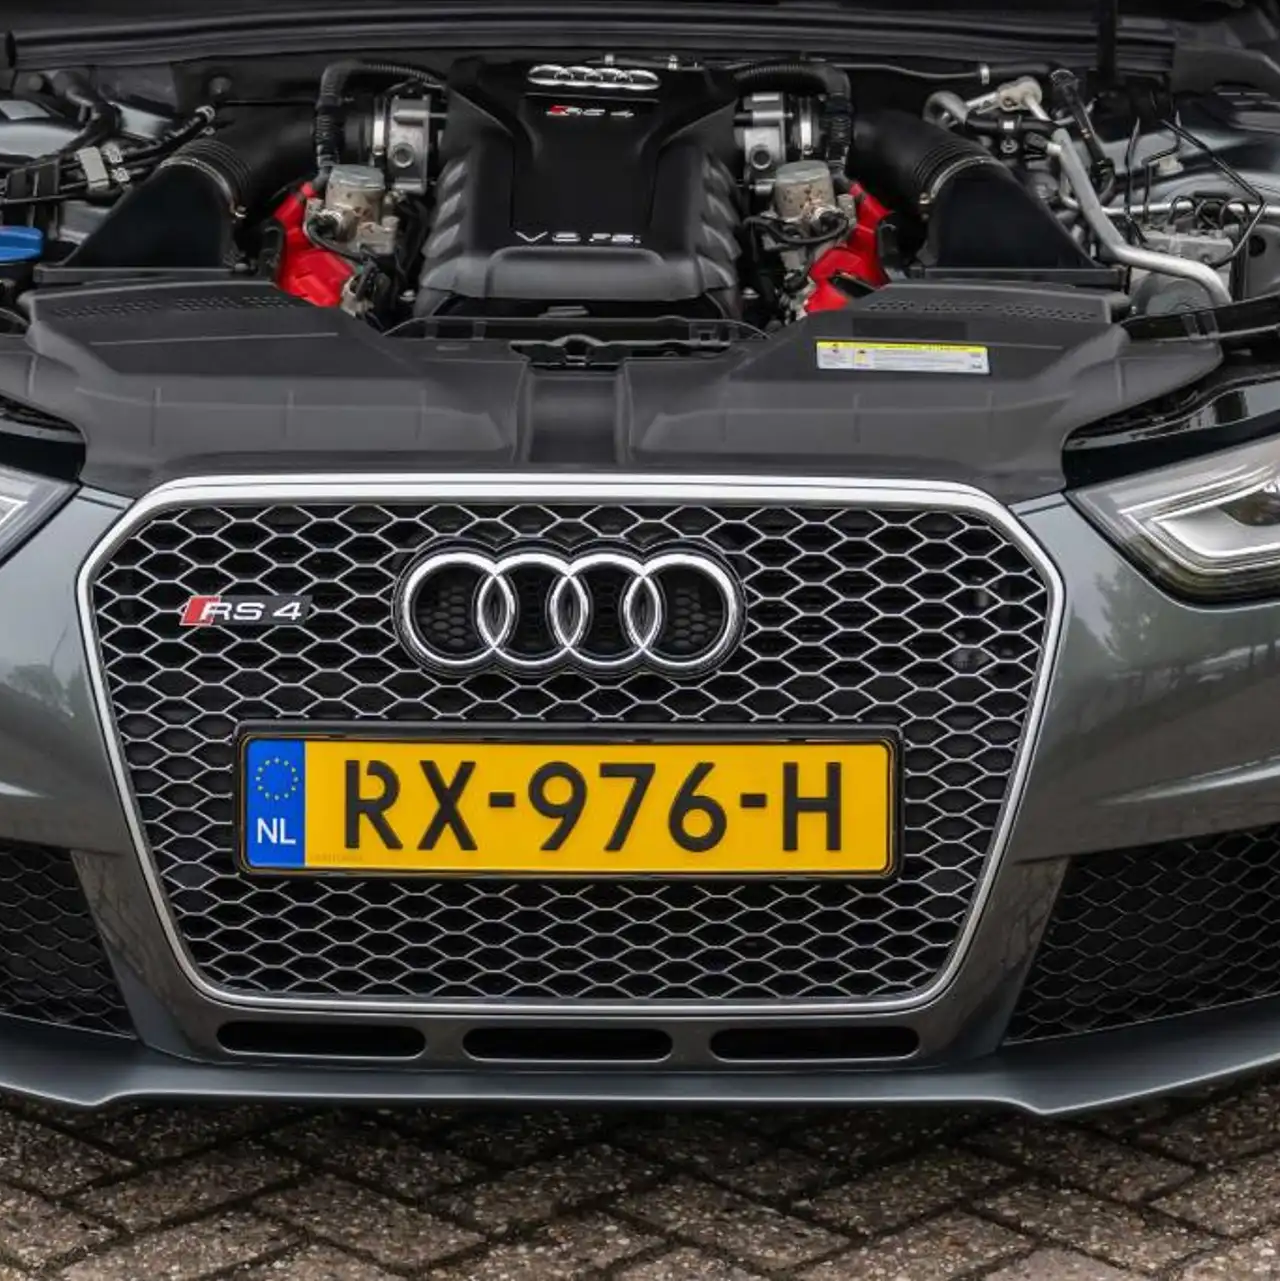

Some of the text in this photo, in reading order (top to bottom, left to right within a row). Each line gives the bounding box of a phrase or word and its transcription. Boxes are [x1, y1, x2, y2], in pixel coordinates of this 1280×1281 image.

[200, 601, 302, 621] RS 4
[344, 759, 842, 853] RX-976-H
[257, 817, 297, 845] NL
